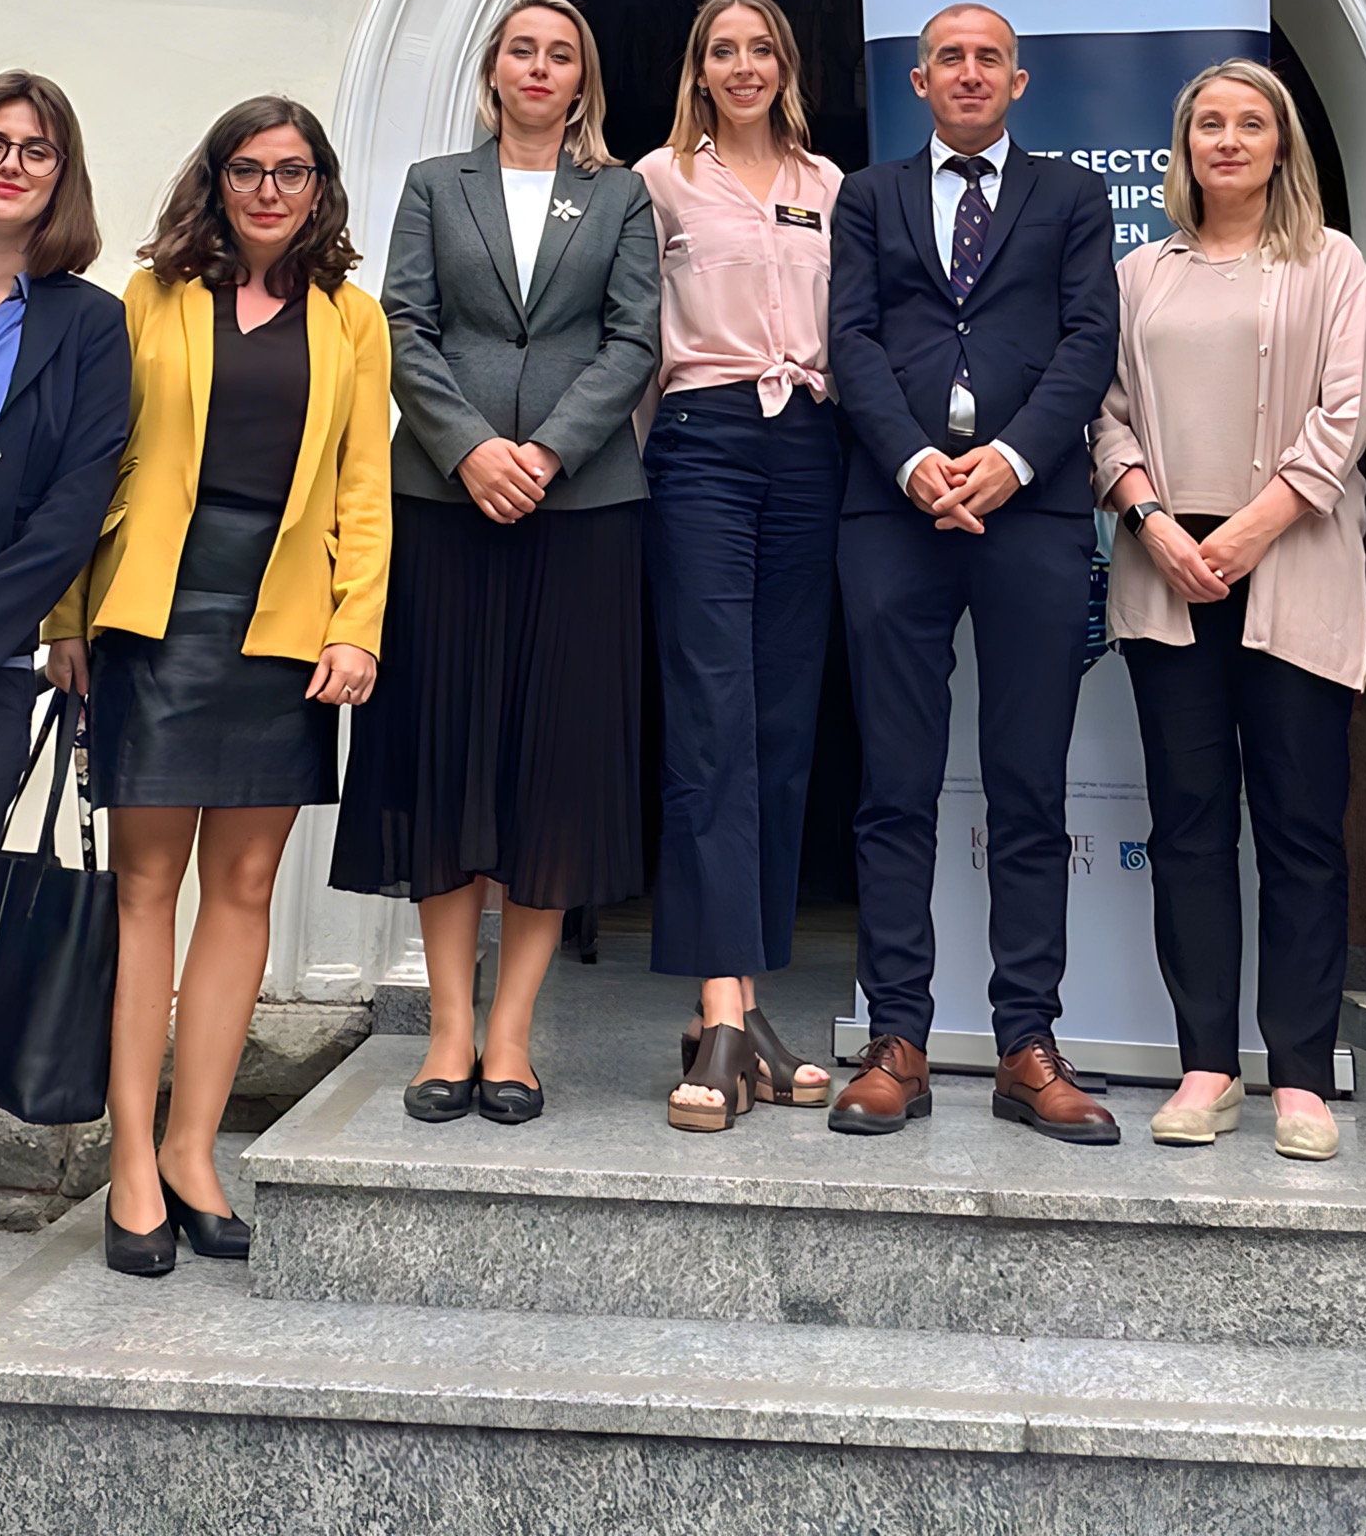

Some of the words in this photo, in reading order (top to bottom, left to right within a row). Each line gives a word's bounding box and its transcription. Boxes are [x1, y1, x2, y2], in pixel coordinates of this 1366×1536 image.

[1071, 148, 1172, 174] SECTO
[1107, 184, 1166, 209] HIPS
[1114, 223, 1149, 244] EN
